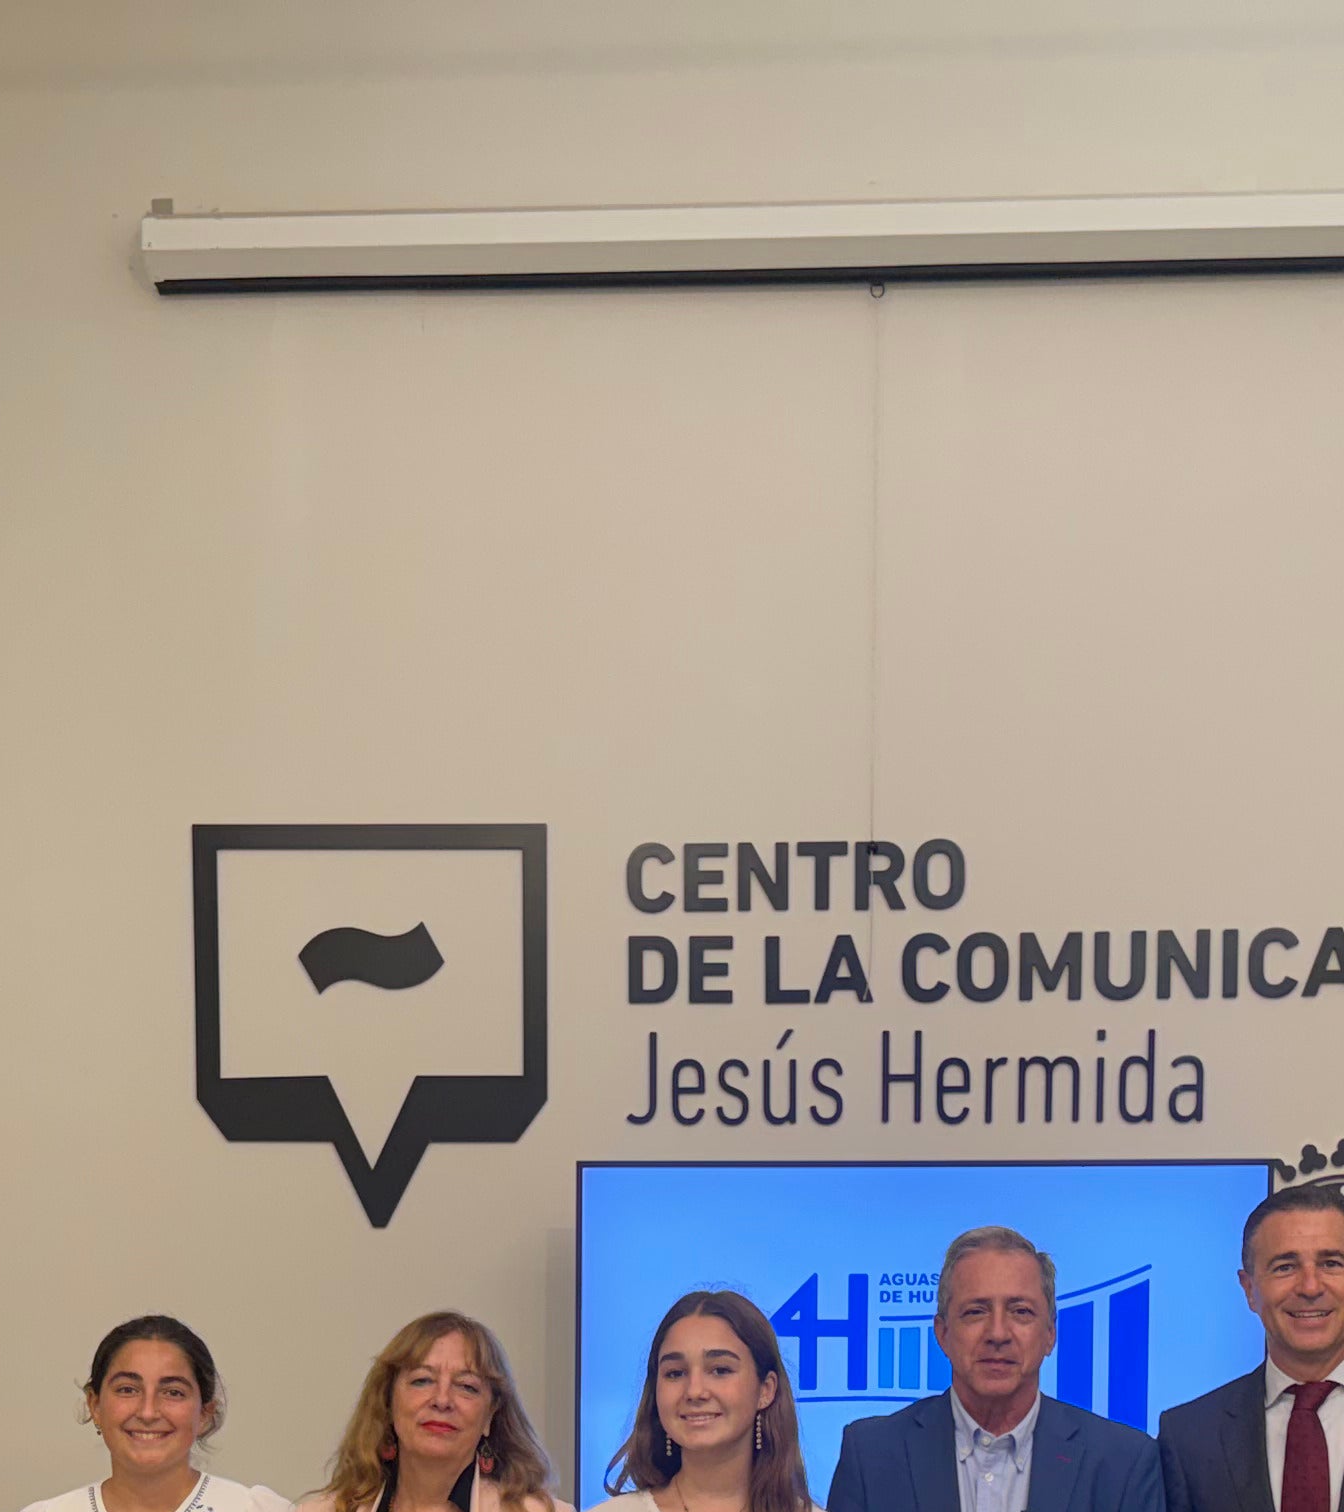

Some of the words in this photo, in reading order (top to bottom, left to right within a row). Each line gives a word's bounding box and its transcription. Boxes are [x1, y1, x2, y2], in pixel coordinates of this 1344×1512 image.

[626, 838, 966, 914] CENTRO
[628, 935, 734, 1004] DE
[764, 934, 874, 1004] LA
[626, 1028, 844, 1126] Jesús
[881, 1028, 1207, 1126] Hermida
[878, 1272, 940, 1286] AGUAS
[879, 1290, 904, 1304] DE
[908, 1290, 939, 1304] HU
